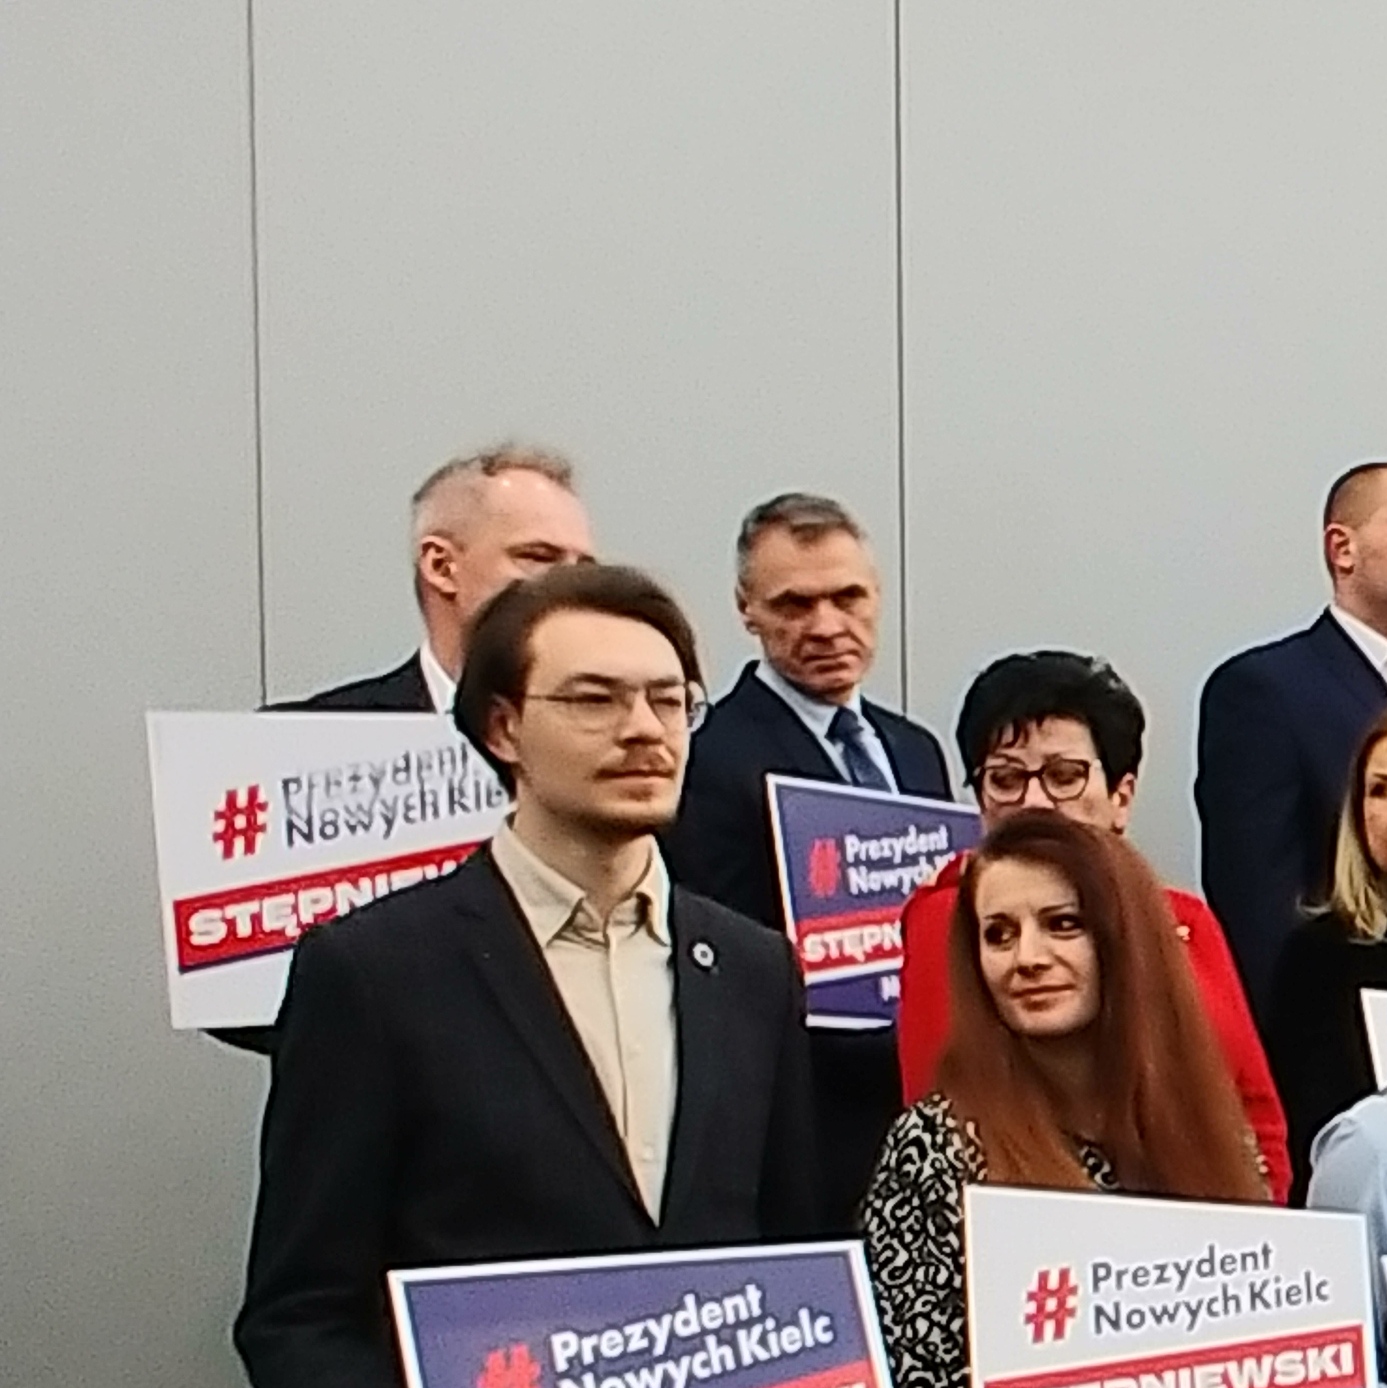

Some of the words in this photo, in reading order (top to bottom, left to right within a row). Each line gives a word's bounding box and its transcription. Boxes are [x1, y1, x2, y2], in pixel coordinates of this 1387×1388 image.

[448, 776, 506, 816] Kie
[845, 824, 948, 864] Prezydent
[1092, 1241, 1273, 1294] Prezydent
[550, 1283, 764, 1373] Prezydent
[1093, 1283, 1242, 1335] Nowych
[1248, 1270, 1331, 1312] Kielc
[737, 1307, 835, 1368] Kielc
